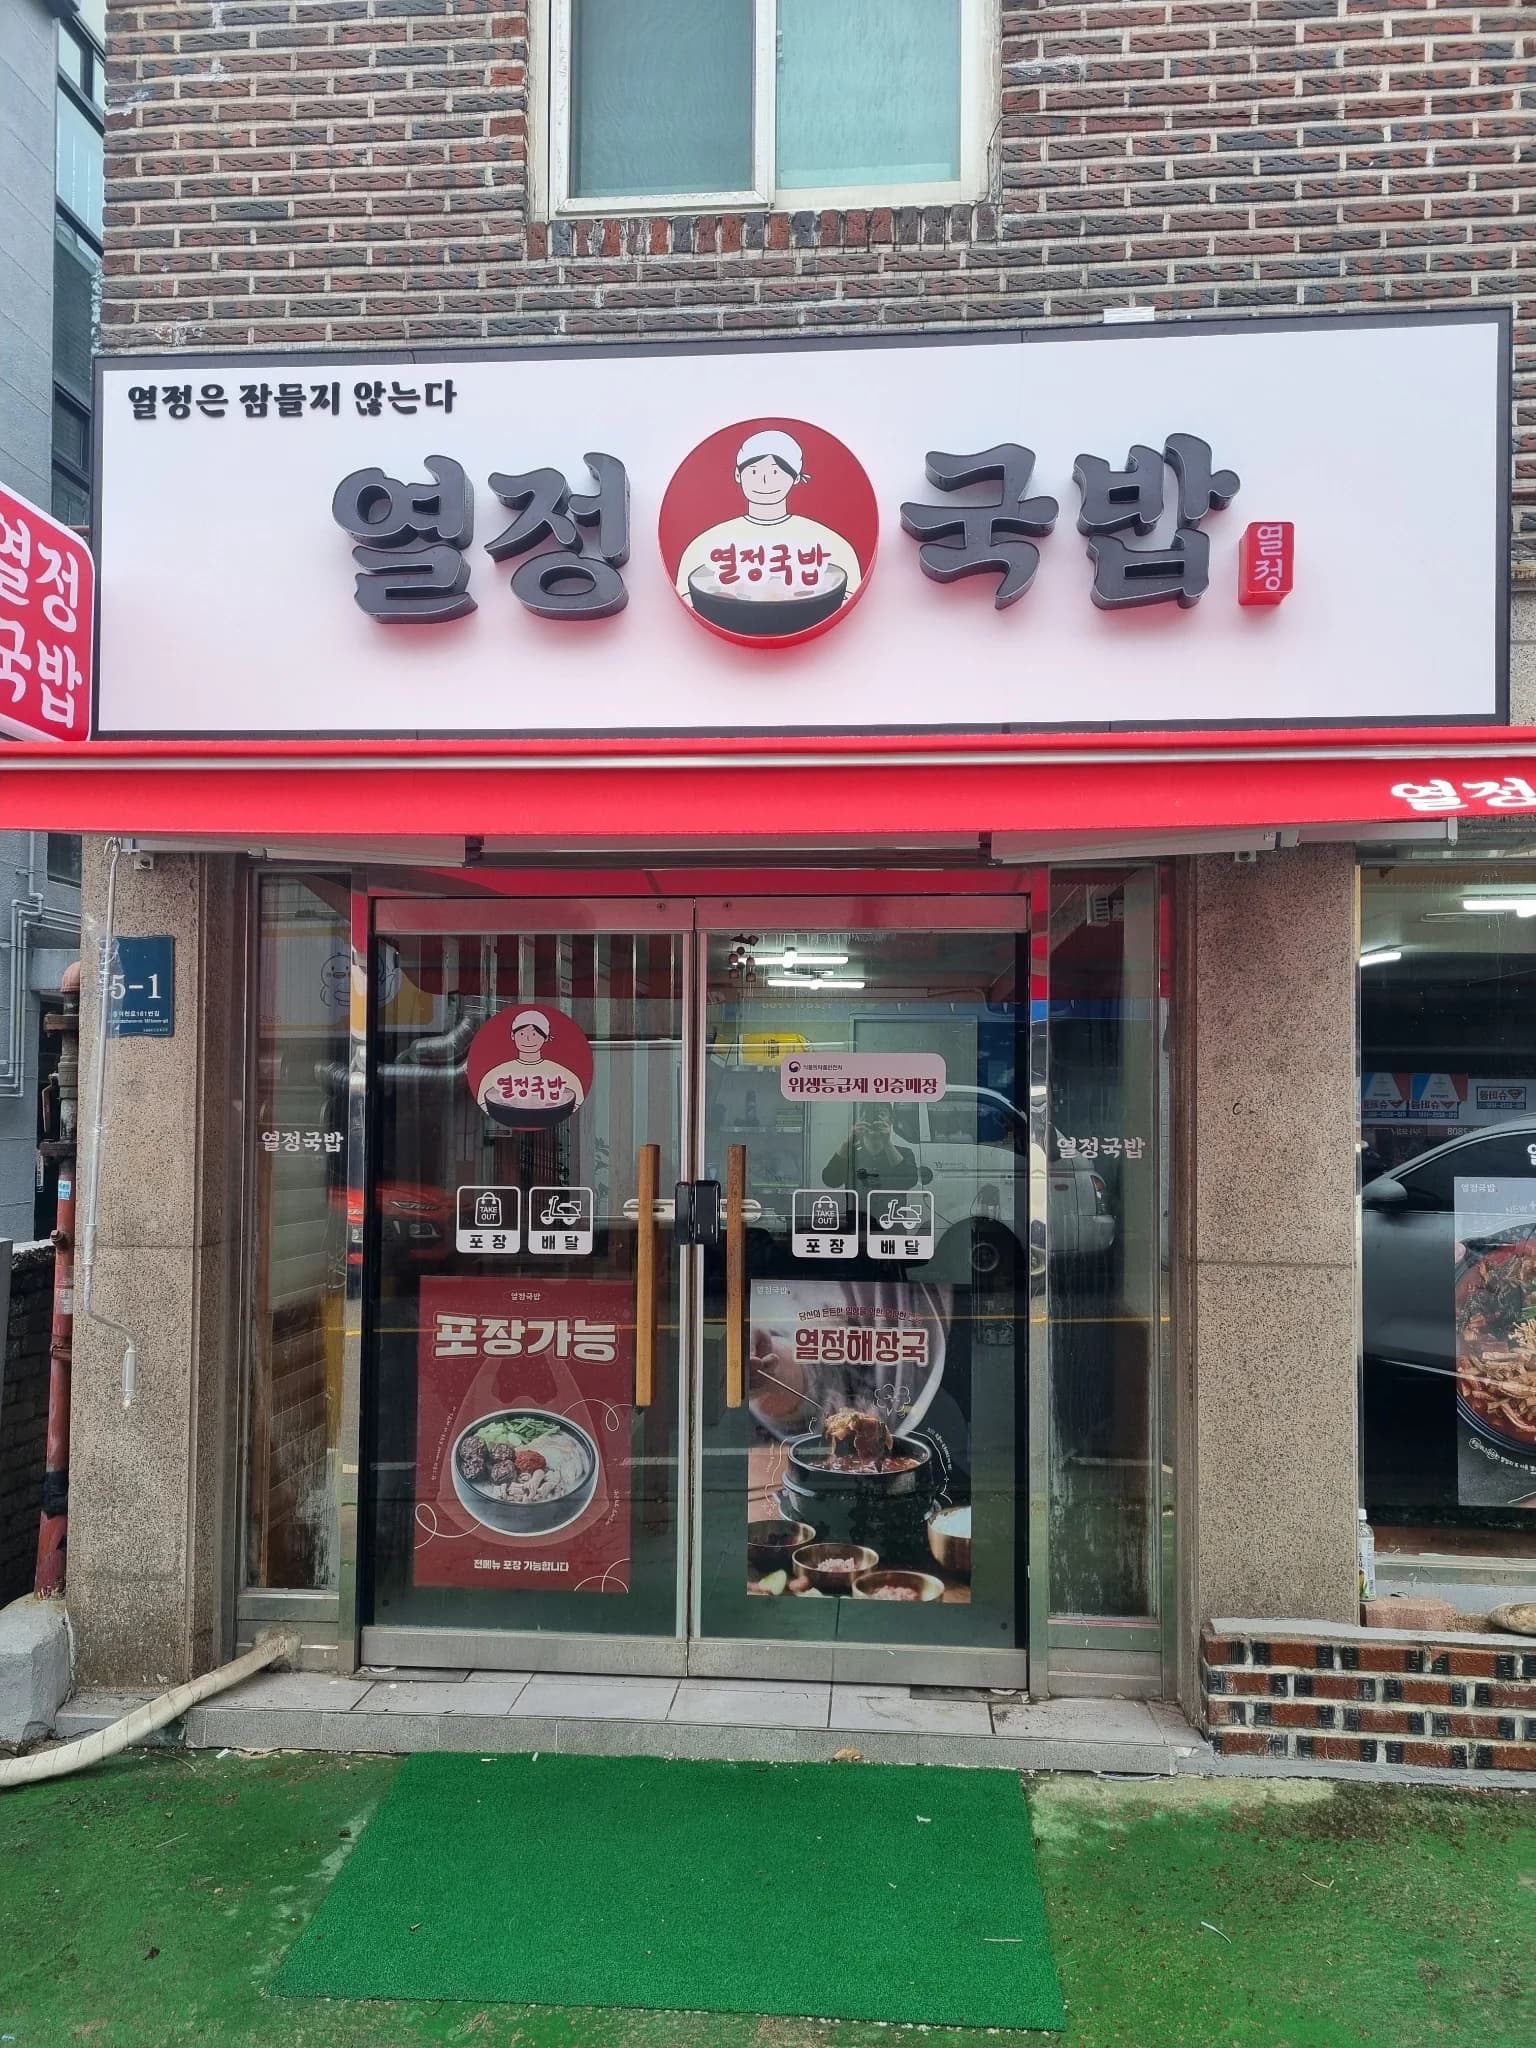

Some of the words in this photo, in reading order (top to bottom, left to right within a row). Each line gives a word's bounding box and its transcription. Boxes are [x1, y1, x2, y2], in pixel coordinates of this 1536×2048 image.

[128, 384, 229, 420] 열정은
[239, 382, 340, 418] 잠들지
[353, 380, 457, 416] 않는다
[332, 452, 631, 624] 열정
[900, 433, 1240, 610] 국밥
[710, 543, 832, 586] 열정국밥
[1391, 777, 1536, 812] 열정
[111, 973, 162, 999] 5-1
[497, 1074, 567, 1101] 열정국밥
[788, 1076, 869, 1094] 위생등급제
[873, 1077, 939, 1095] 인증매장
[261, 1130, 344, 1153] 열정국밥
[1056, 1136, 1146, 1159] 열정국밥
[479, 1206, 498, 1214] TAKE
[481, 1213, 496, 1221] OUT
[816, 1210, 835, 1218] TAKE
[818, 1217, 833, 1225] OUT
[510, 1291, 541, 1301] 열정국밥
[435, 1314, 616, 1362] 포장가능
[795, 1328, 926, 1364] 열정해장국
[474, 1559, 501, 1570] 전메뉴
[503, 1560, 521, 1571] 포장
[523, 1561, 570, 1572] 가능합니다
